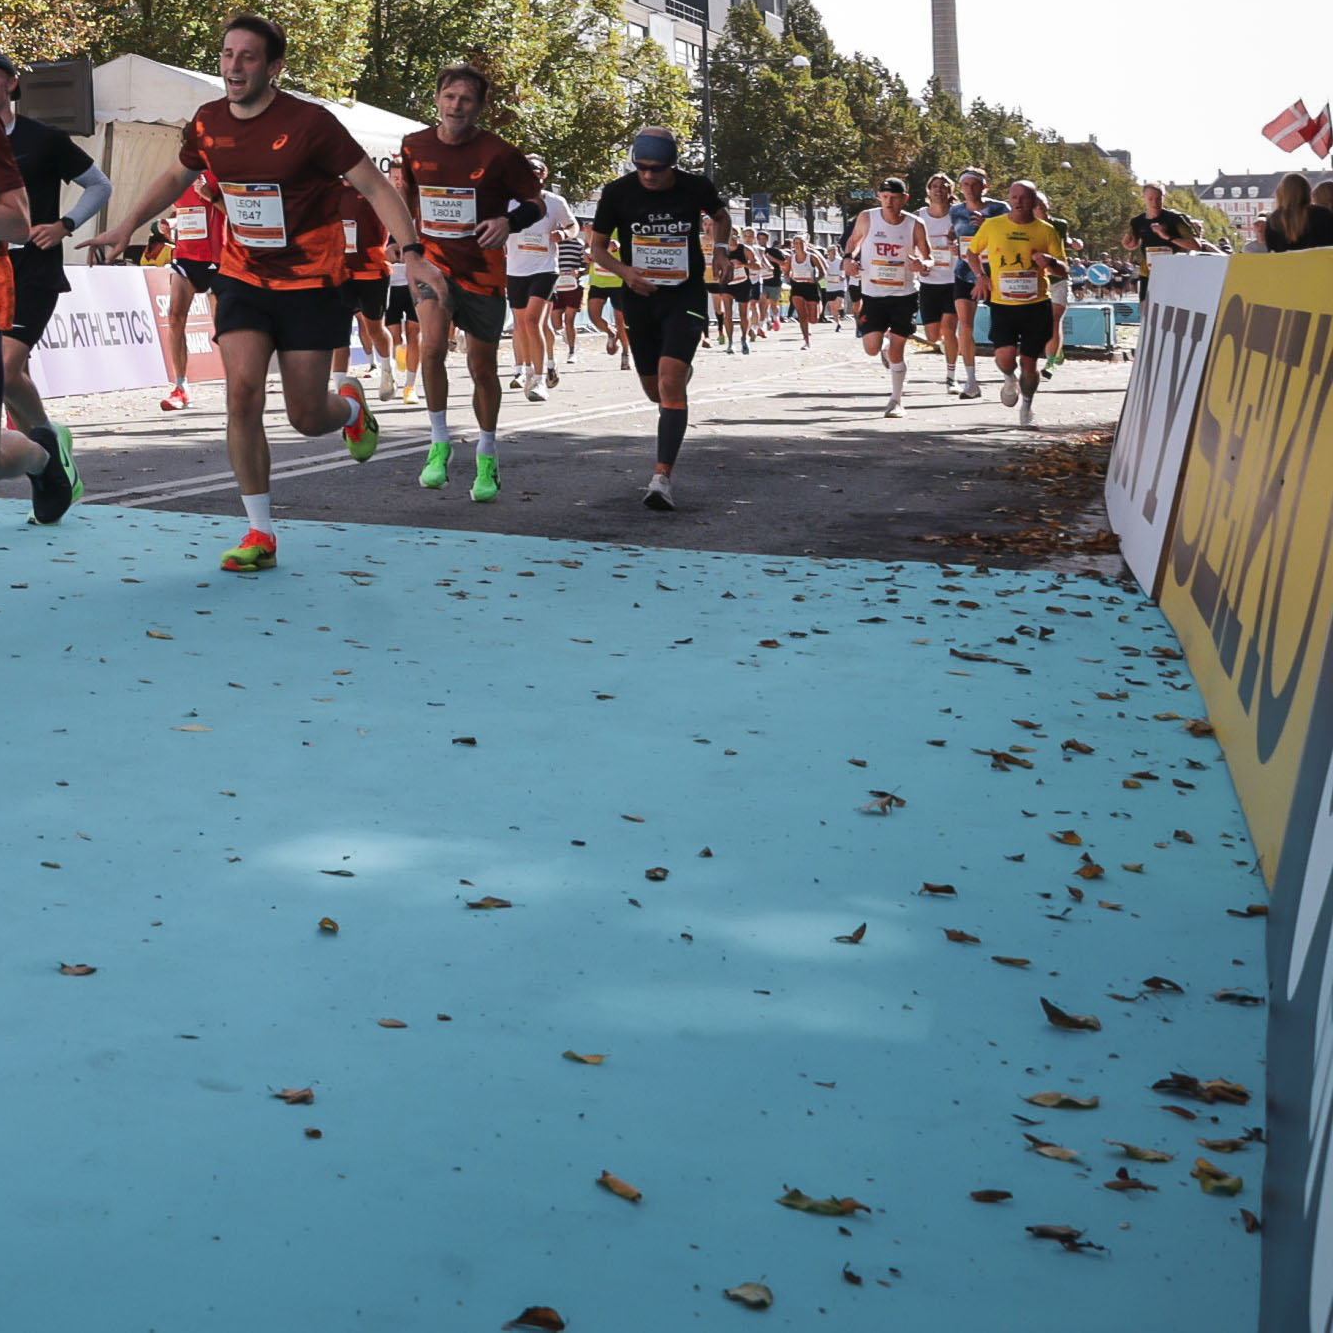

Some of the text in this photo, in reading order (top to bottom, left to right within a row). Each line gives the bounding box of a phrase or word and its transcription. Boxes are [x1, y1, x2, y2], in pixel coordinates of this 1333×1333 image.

[235, 199, 261, 208] LEON
[429, 199, 463, 209] HILMAR
[630, 221, 692, 235] Cometa
[636, 246, 683, 256] RICCARDO
[644, 256, 675, 266] 12942
[70, 310, 154, 349] ATHLETICS
